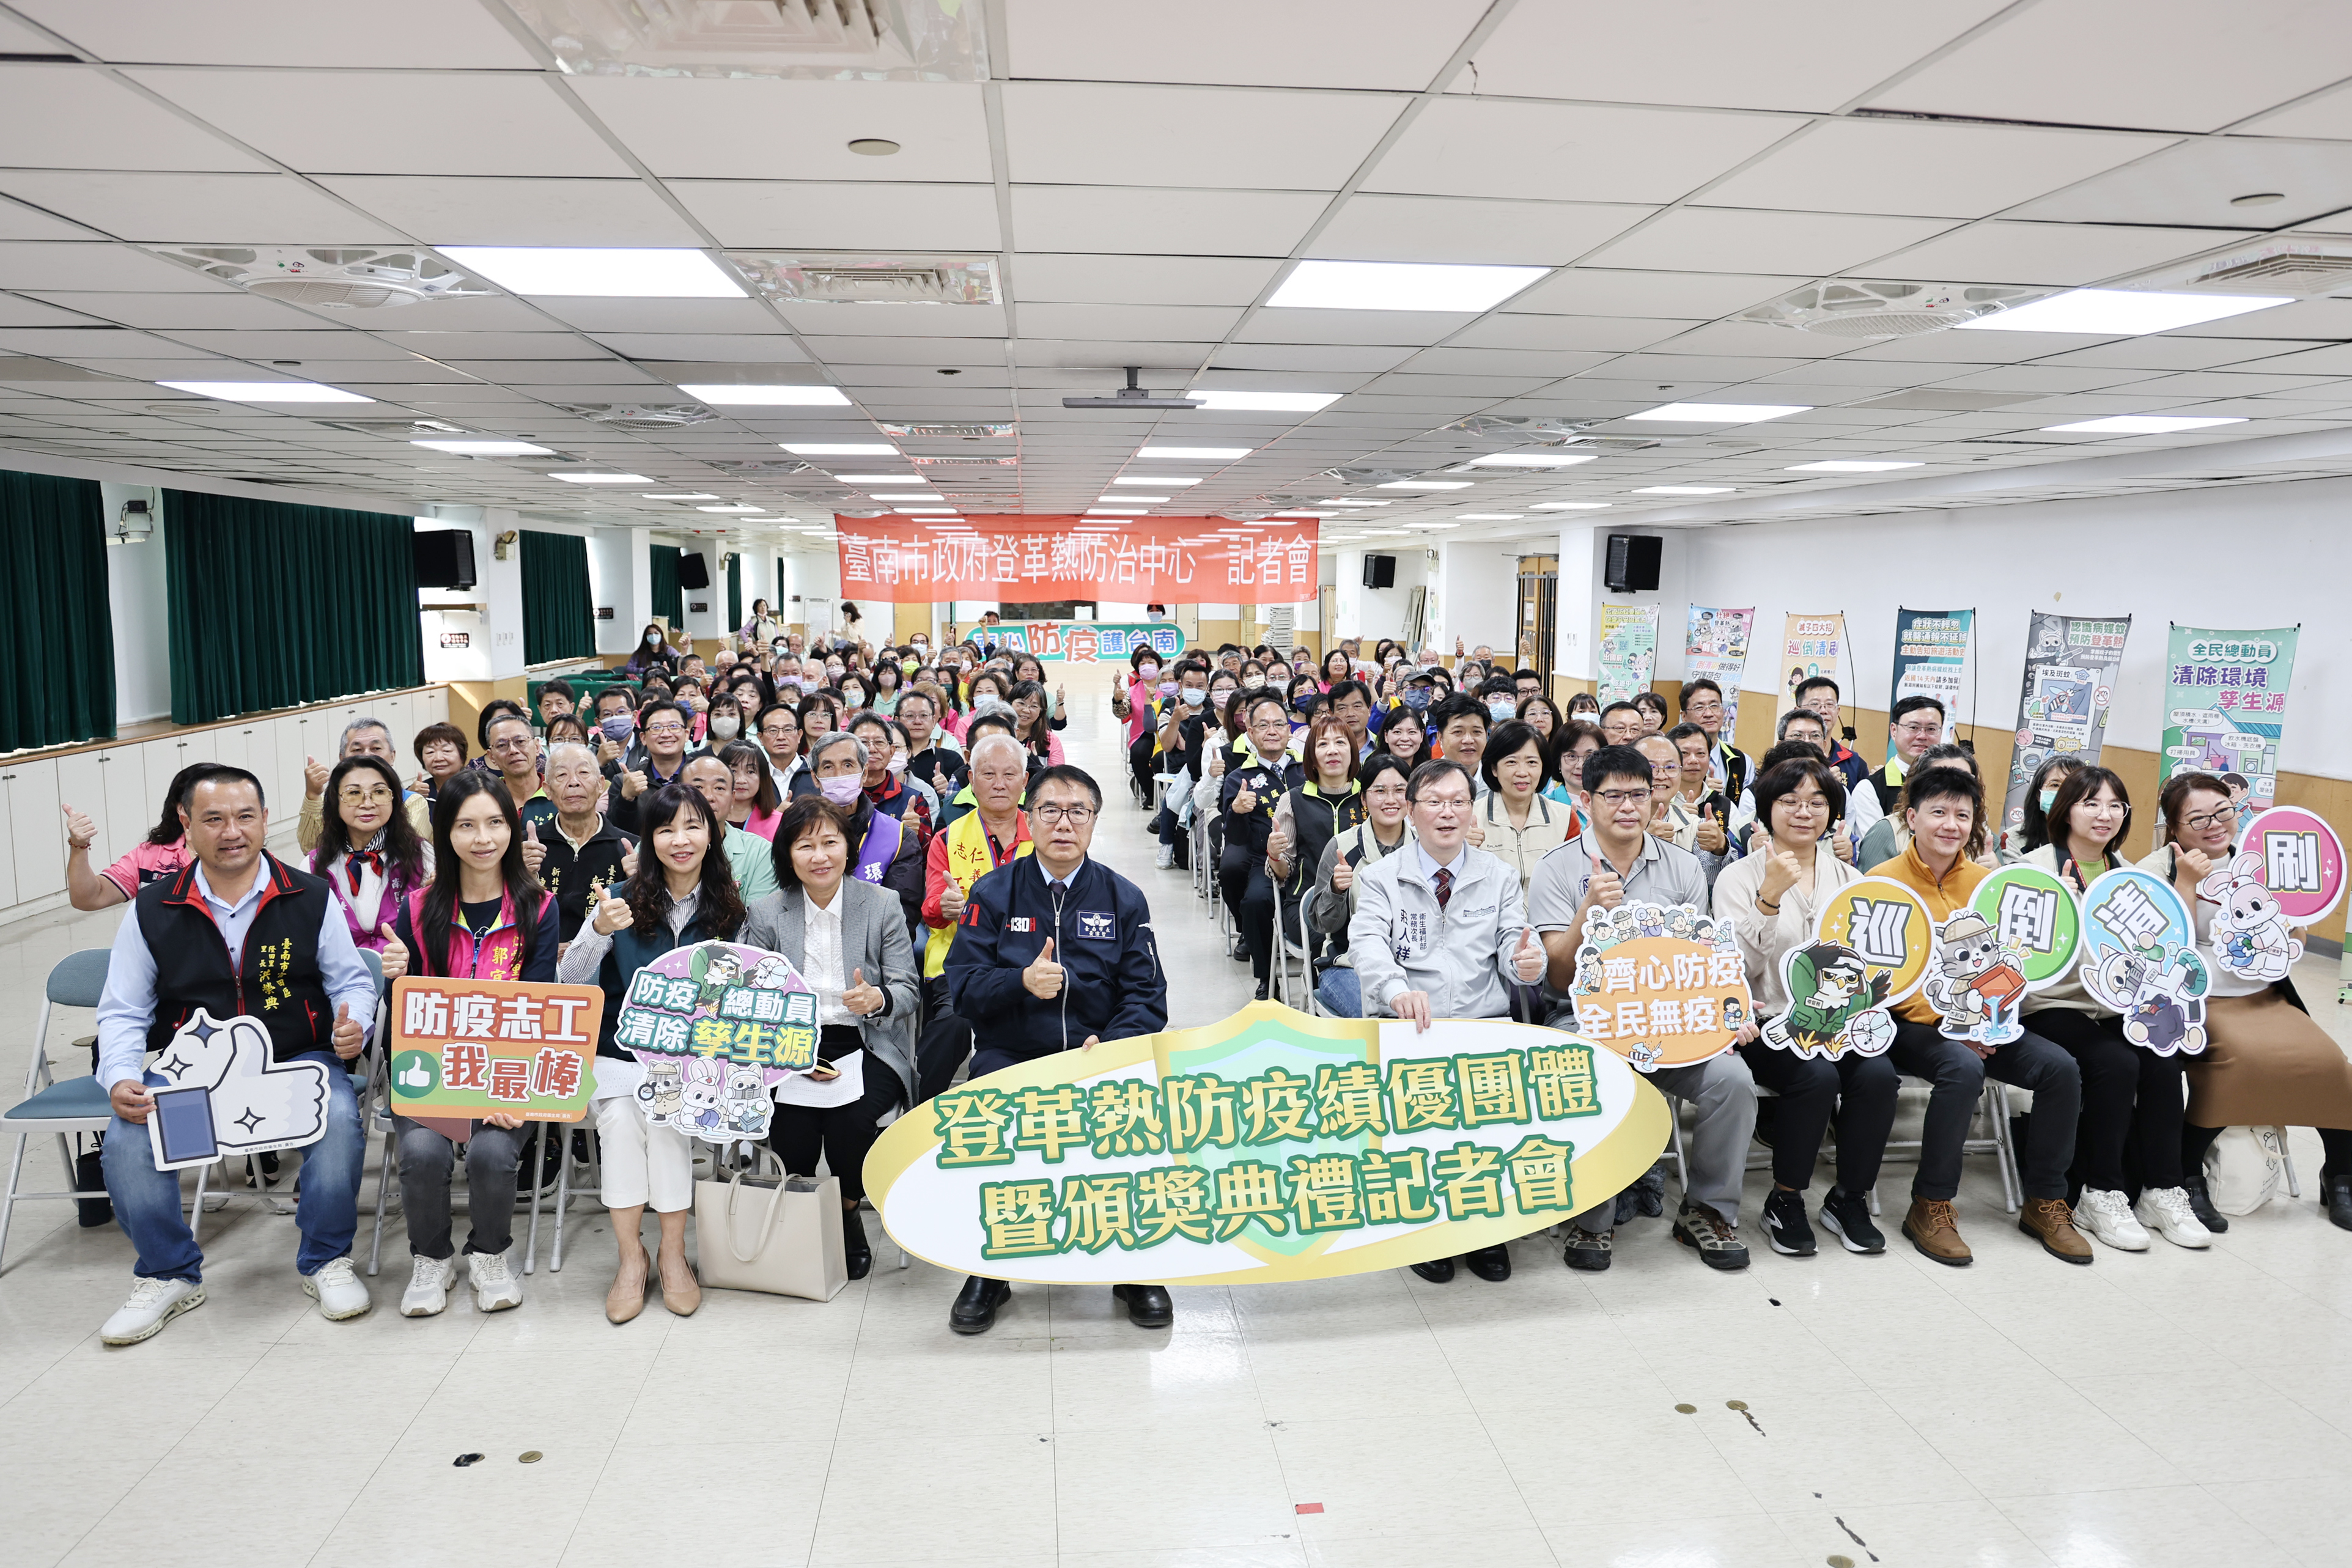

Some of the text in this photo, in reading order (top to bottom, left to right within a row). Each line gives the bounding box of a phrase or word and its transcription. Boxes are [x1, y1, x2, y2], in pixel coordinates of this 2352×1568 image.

[844, 533, 1311, 586] 臺南市政府登革熱防治中心 記者會
[1903, 631, 1967, 644] 就醫通報不延誤
[1912, 619, 1960, 631] 症狀不輕忽
[2069, 633, 2124, 647] 預防登革熱
[2070, 621, 2126, 635] 認識病媒蚊
[1788, 639, 1839, 657] 巡倒清刷
[2192, 642, 2272, 658] 全民總動員
[2042, 669, 2071, 679] 埃及斑蚊
[2172, 664, 2268, 688] 清除環境
[2217, 690, 2285, 713] 孳生源
[551, 867, 561, 895] 新北里
[2265, 833, 2320, 893] 刷
[1419, 913, 1428, 951] 衛生福利部
[1851, 899, 1910, 966] 巡
[1999, 884, 2058, 954] 倒
[268, 945, 277, 967] 隆田里
[1604, 950, 1741, 995] 齊心防疫
[259, 969, 280, 1011] 洪榮典
[634, 974, 816, 1025] 防疫 總動員
[406, 992, 589, 1042] 防疫志工
[621, 1010, 814, 1066] 清除 孳生源
[1579, 995, 1716, 1040] 全民無疫
[445, 1045, 582, 1099] 我最棒
[939, 1047, 1598, 1167] 登革熱防疫績優團體
[982, 1136, 1574, 1258] 暨頒獎典禮記者會
